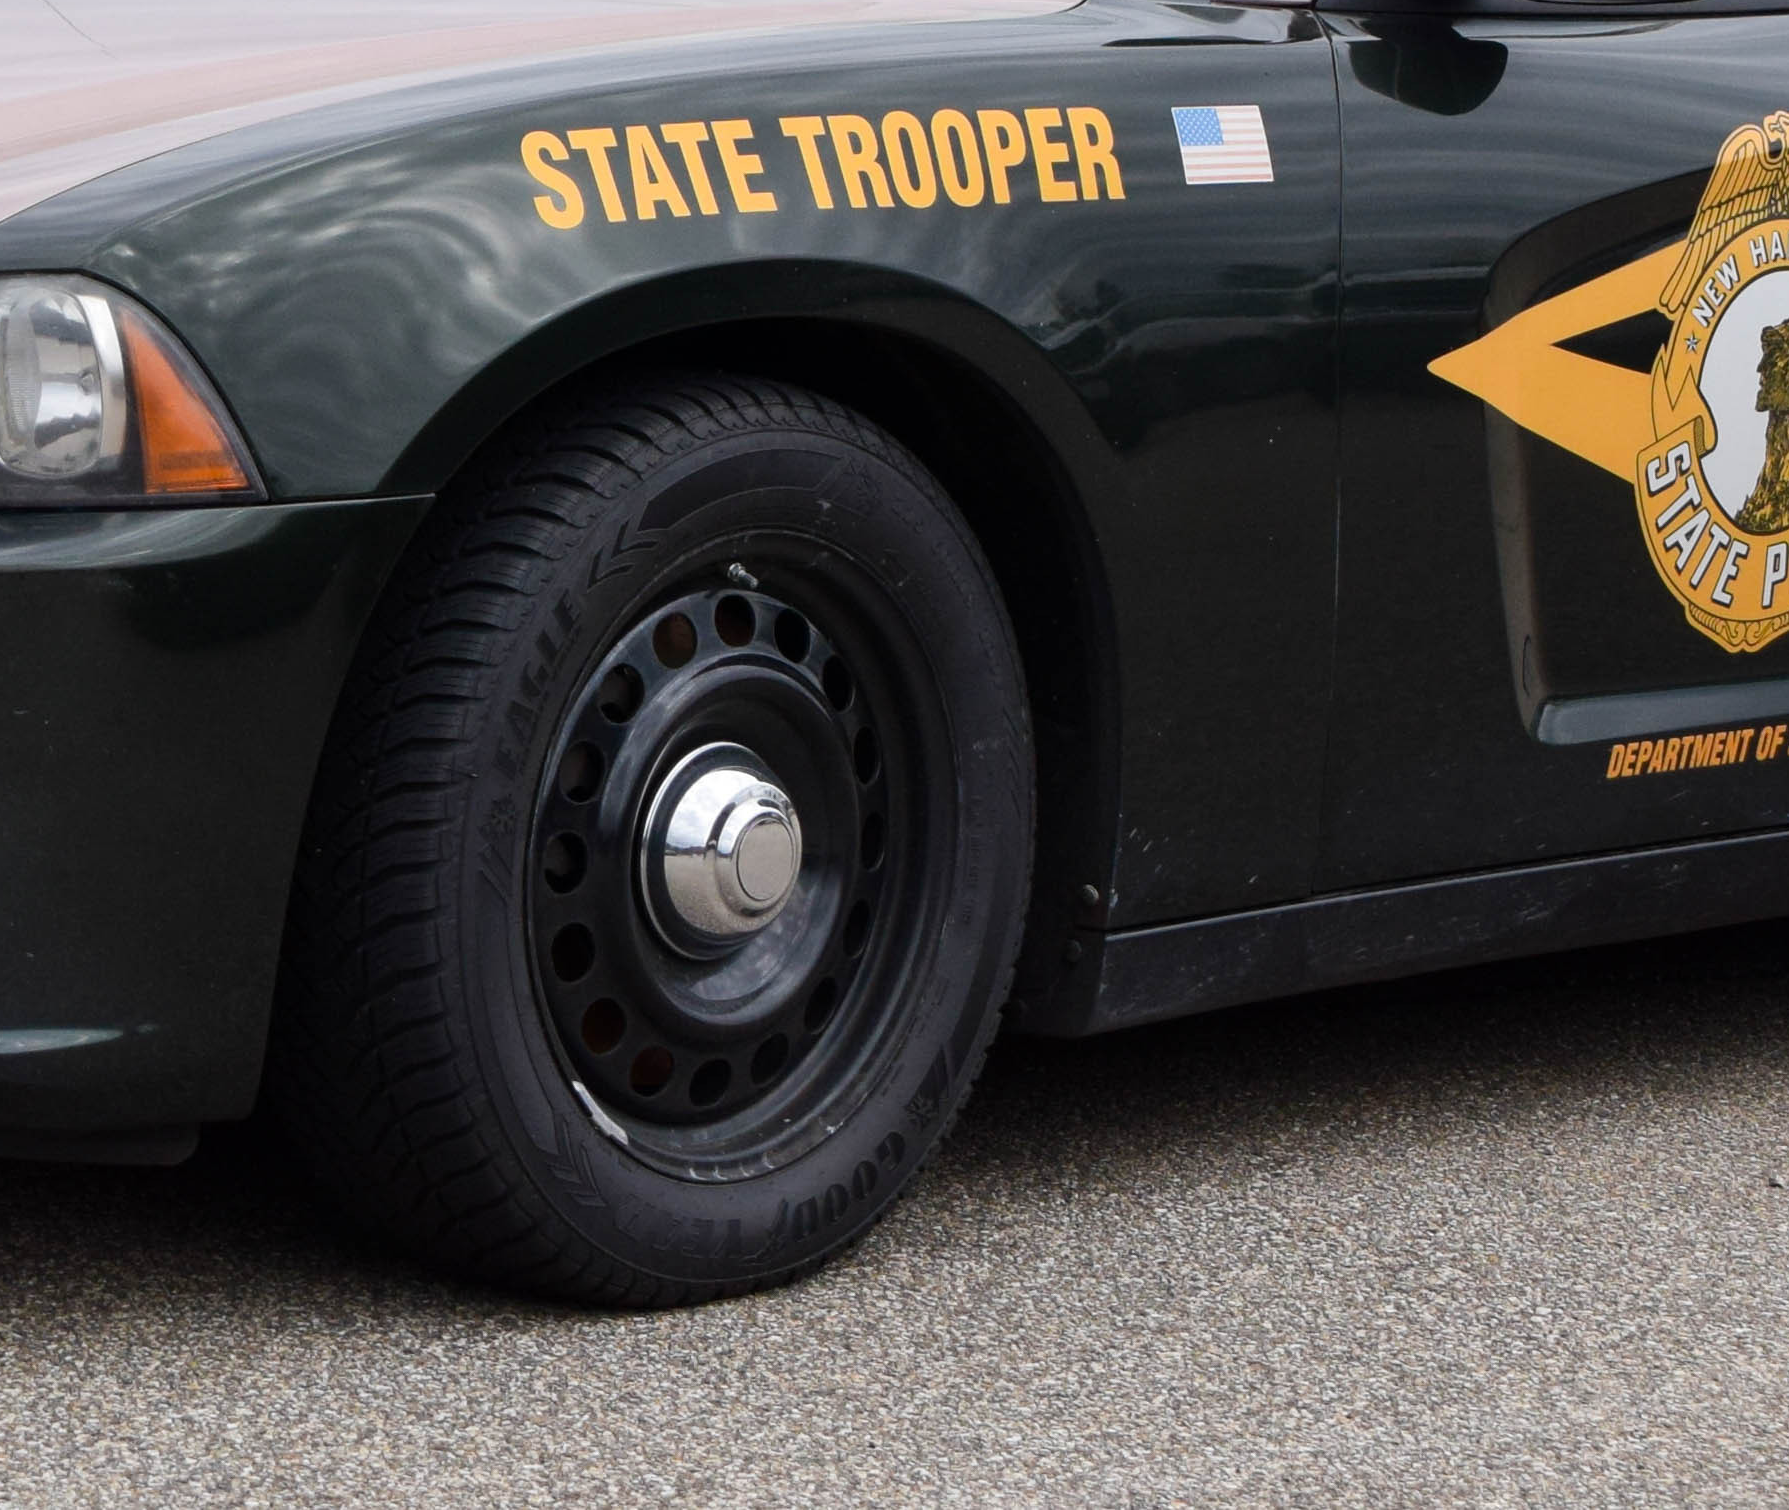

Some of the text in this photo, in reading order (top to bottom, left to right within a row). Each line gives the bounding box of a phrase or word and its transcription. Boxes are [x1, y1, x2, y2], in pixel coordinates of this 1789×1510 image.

[520, 107, 1126, 230] STATE TROOPER
[1691, 254, 1742, 329] NEW
[1645, 440, 1750, 608] STATE
[495, 587, 581, 780] EAGLE
[1606, 728, 1755, 780] DEPARTMENT
[1755, 724, 1787, 761] OF
